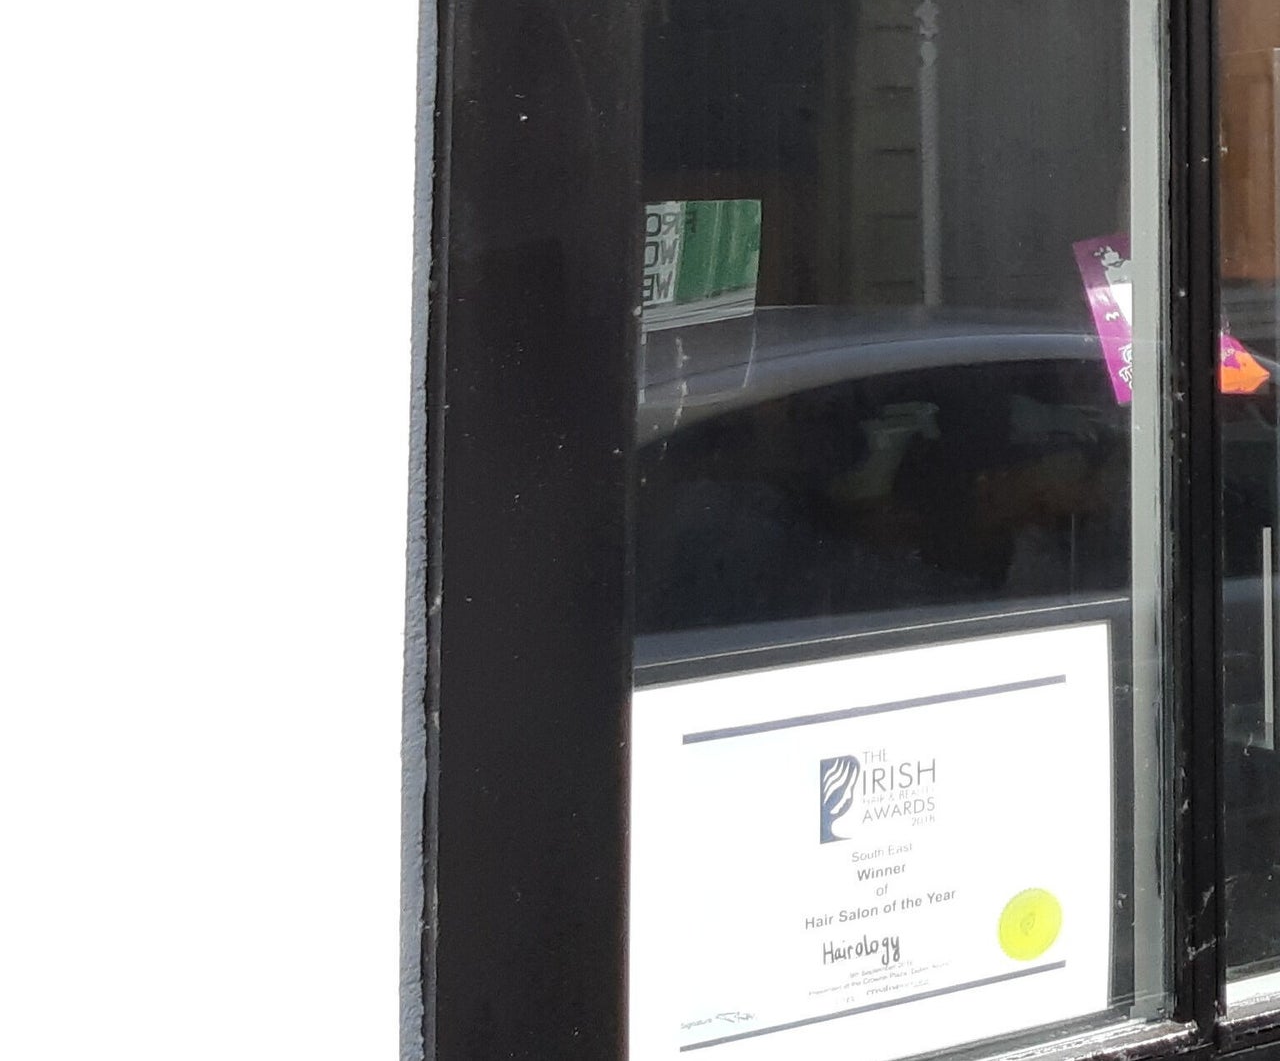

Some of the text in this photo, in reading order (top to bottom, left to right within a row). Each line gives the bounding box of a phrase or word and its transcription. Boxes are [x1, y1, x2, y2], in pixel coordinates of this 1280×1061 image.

[862, 757, 936, 796] IRISH
[861, 795, 936, 824] AWARDS
[851, 847, 884, 864] South
[856, 862, 906, 882] Winner
[875, 883, 889, 897] of
[804, 889, 957, 930] Hair Salon of the Year
[821, 931, 901, 966] Hairology
